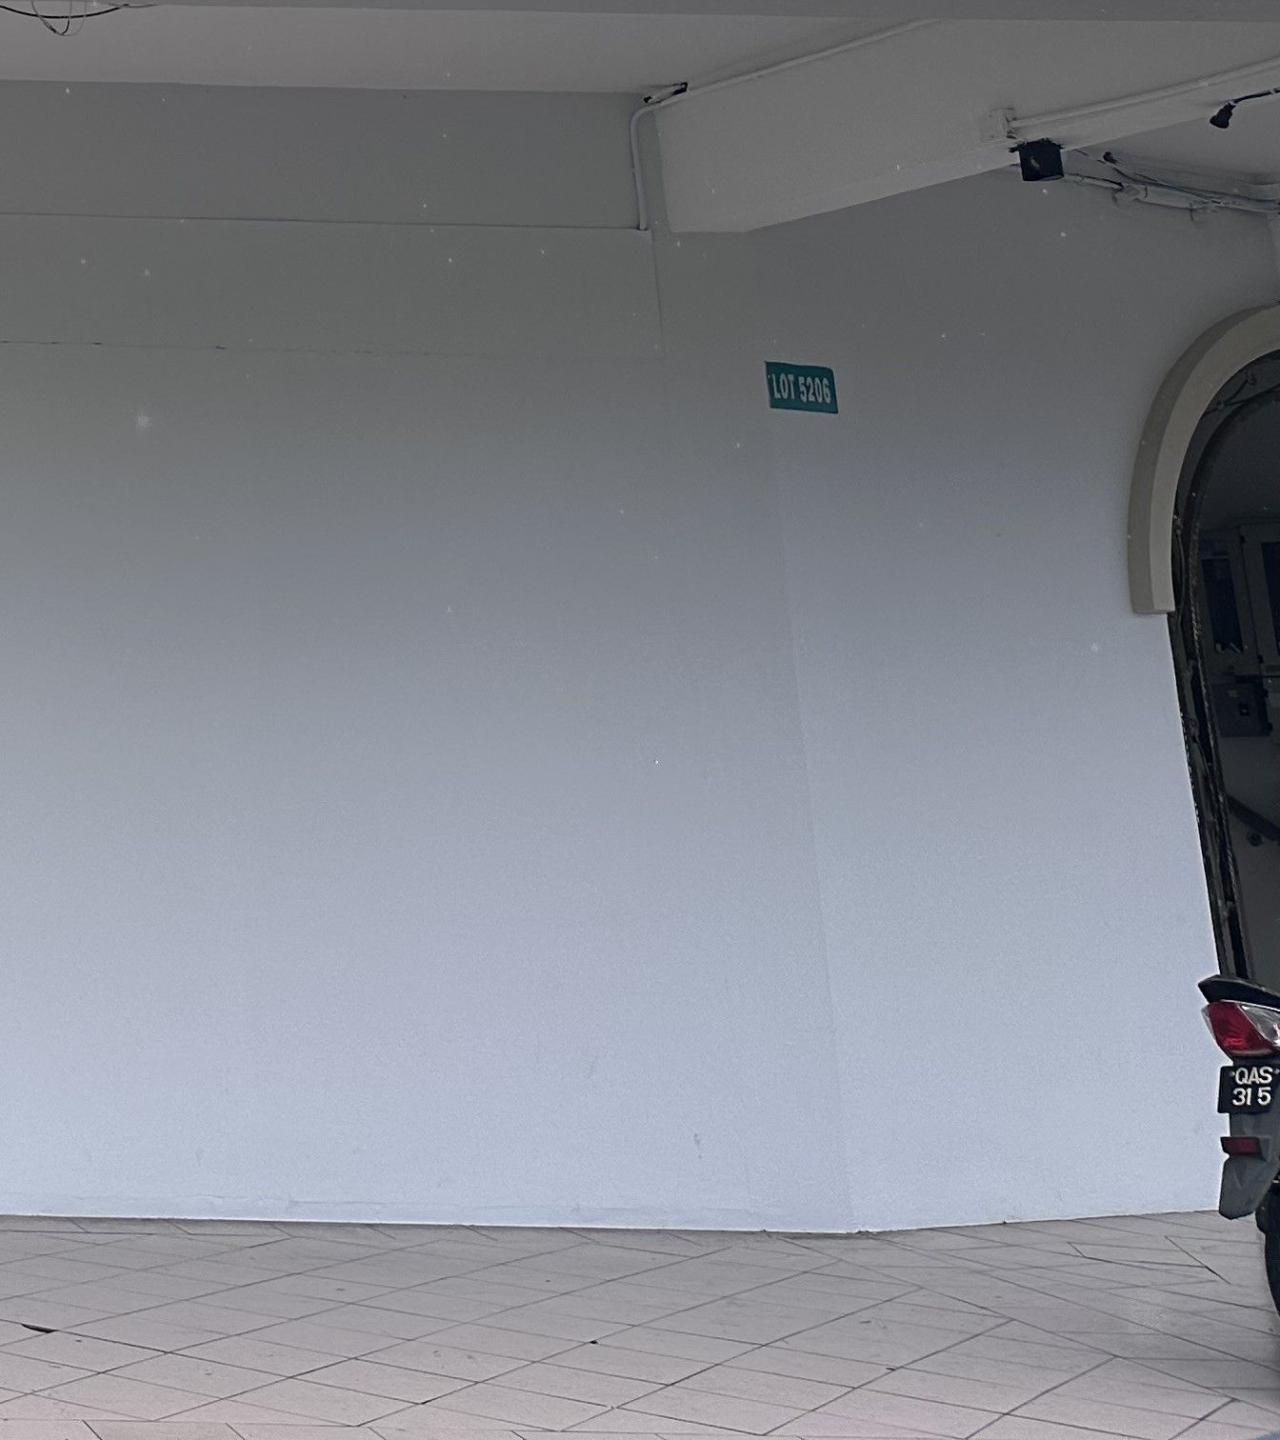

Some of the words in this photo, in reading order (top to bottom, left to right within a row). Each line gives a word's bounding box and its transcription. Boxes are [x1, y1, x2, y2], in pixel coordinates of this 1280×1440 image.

[772, 373, 795, 400] LOT
[798, 376, 831, 404] 5206
[1235, 1066, 1272, 1085] QAS
